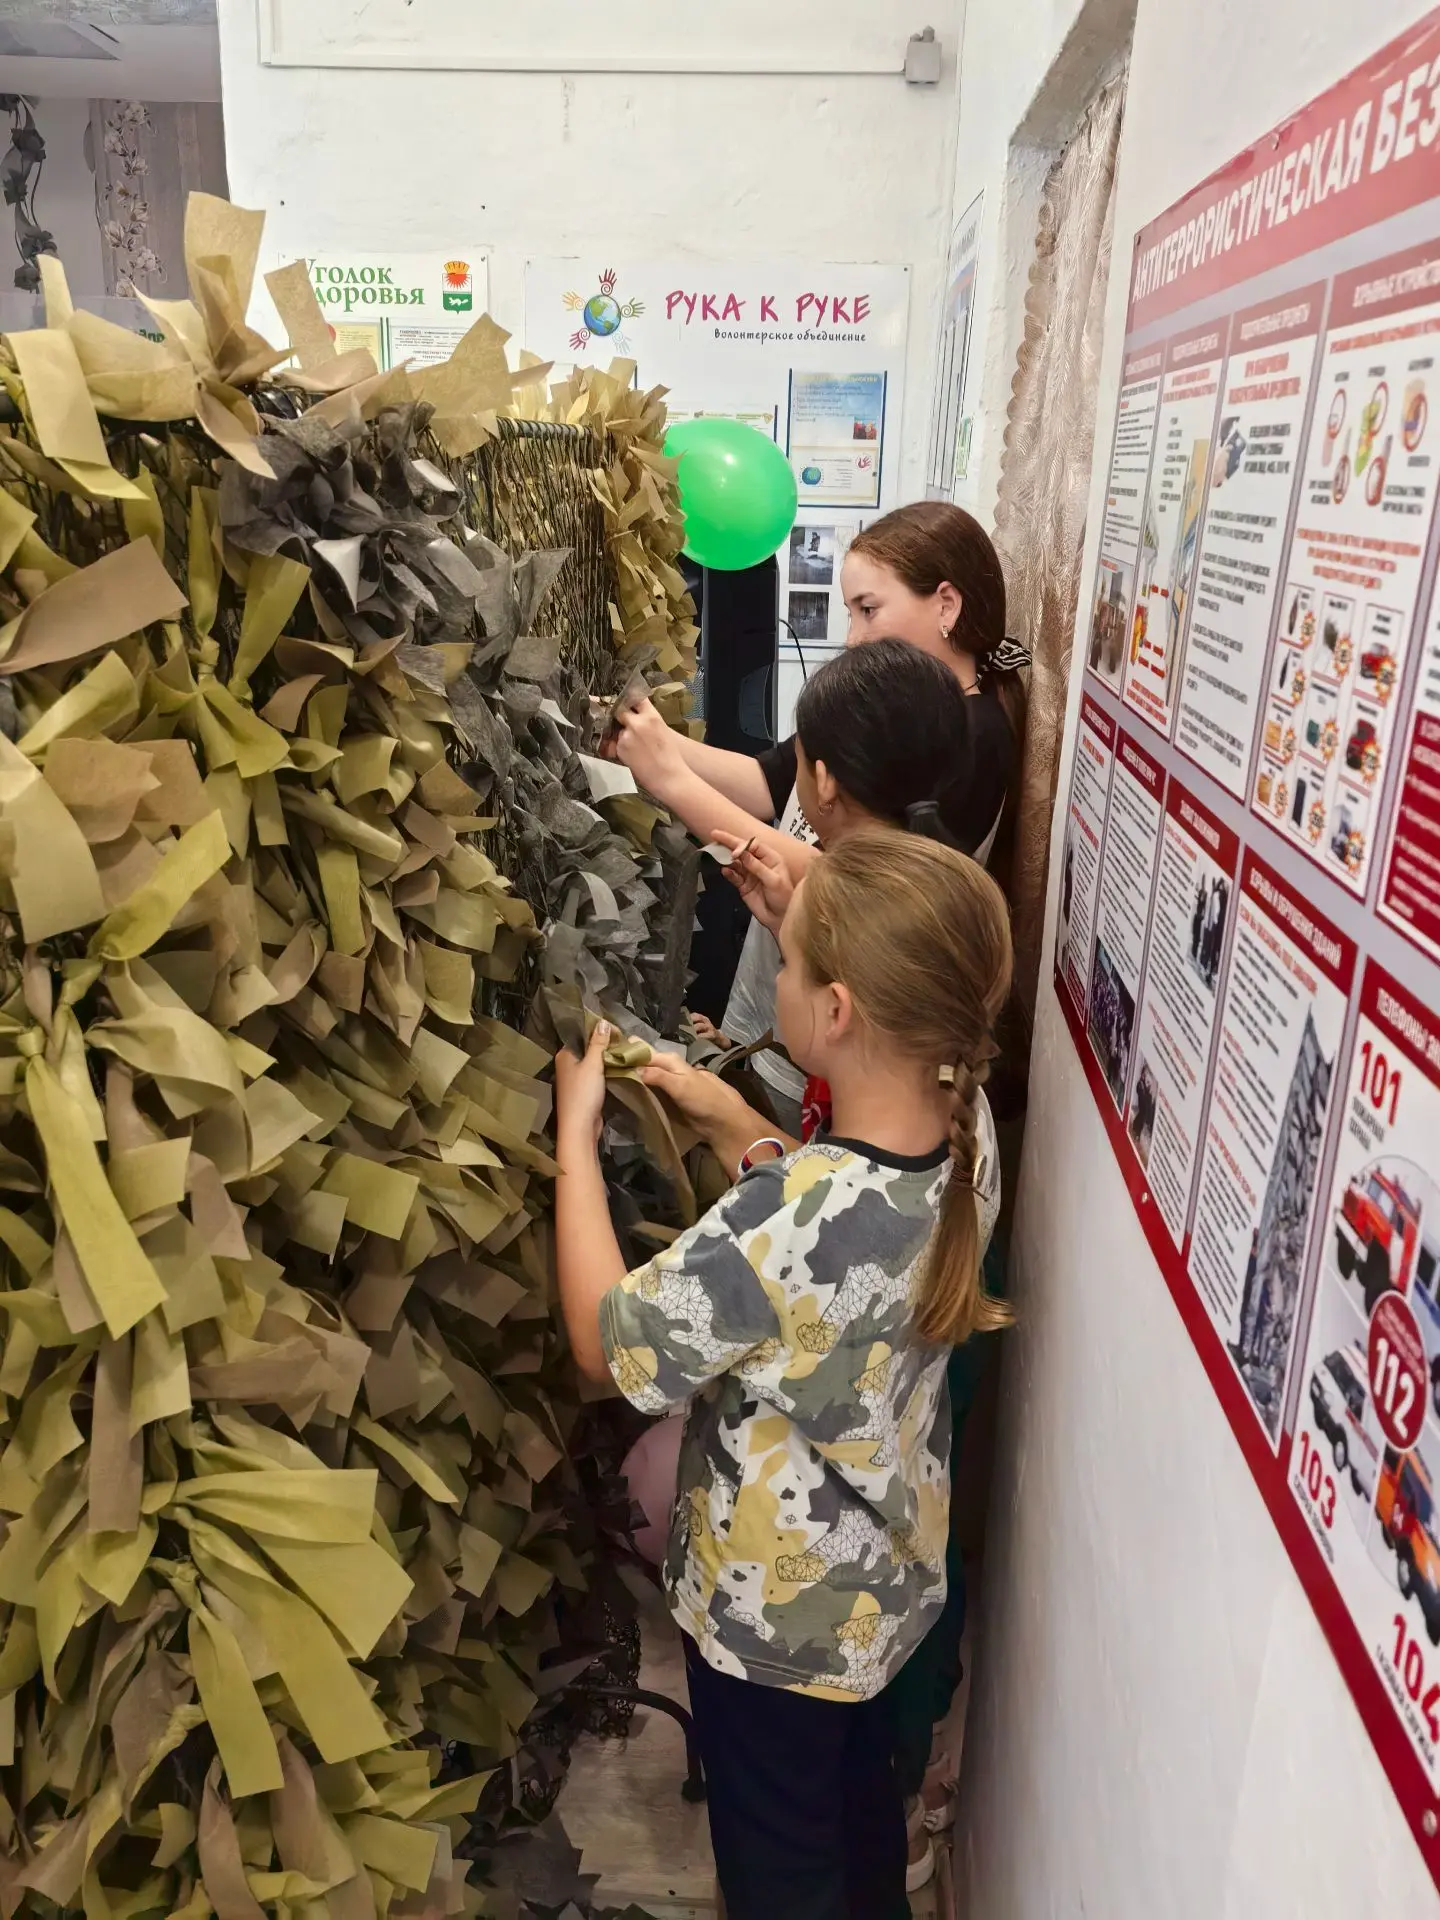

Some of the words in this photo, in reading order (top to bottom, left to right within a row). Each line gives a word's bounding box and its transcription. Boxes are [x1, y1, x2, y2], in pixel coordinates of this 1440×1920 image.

[1131, 100, 1373, 303] АНТИТЕРРОРИСТИЧЕСКАЯ
[665, 290, 747, 325] РУКА
[760, 295, 779, 322] К
[795, 292, 871, 328] РУКЕ
[796, 328, 866, 342] объединение
[1360, 1039, 1402, 1128] 101
[1373, 1336, 1416, 1440] 112
[1300, 1430, 1336, 1530] 103
